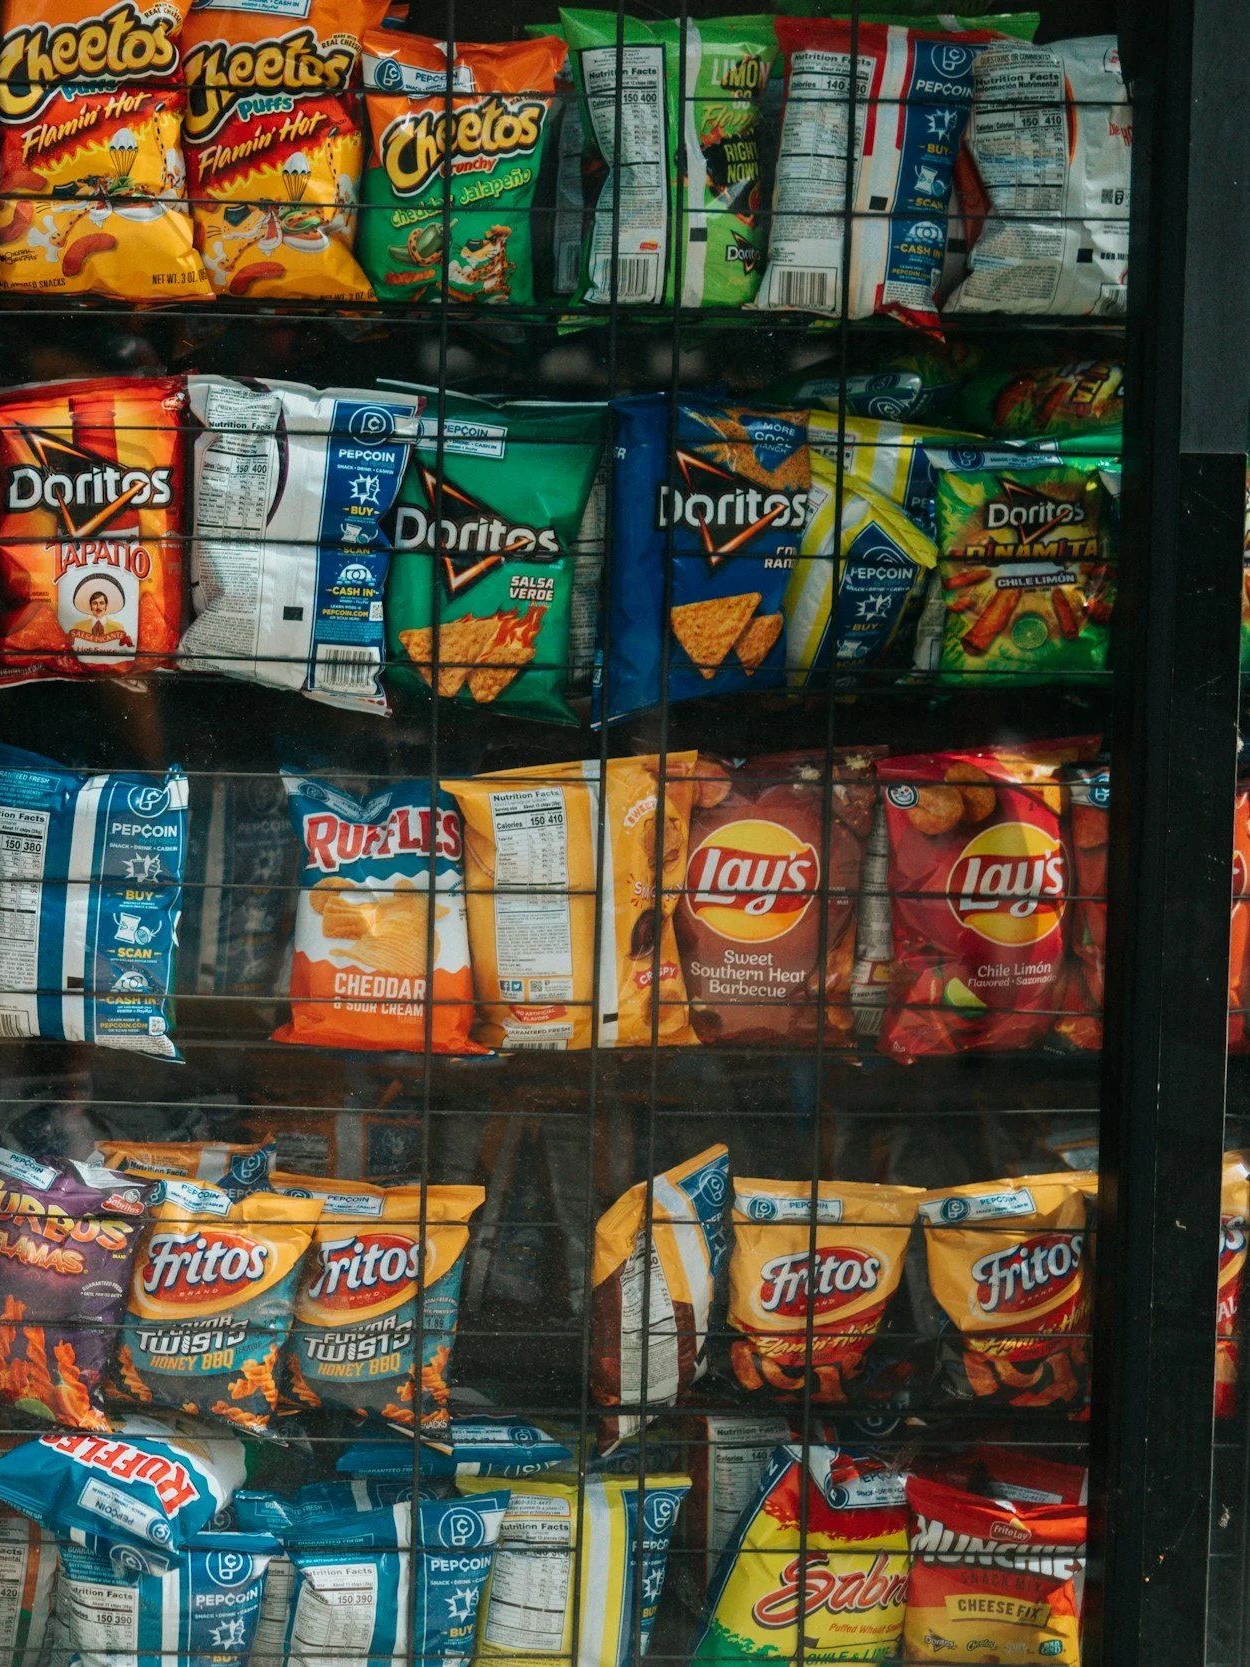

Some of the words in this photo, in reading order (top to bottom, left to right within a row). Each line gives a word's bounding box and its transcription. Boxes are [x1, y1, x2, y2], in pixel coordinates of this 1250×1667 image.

[0, 8, 173, 118] Cheetos
[632, 68, 656, 76] Facts
[185, 36, 353, 134] Cheetos
[827, 81, 844, 91] 140
[623, 93, 638, 103] 150
[640, 93, 657, 103] 400
[22, 107, 99, 164] Flamin'
[104, 93, 151, 117] Hot
[1021, 118, 1038, 126] 150
[1045, 116, 1062, 125] 410
[198, 129, 276, 184] Flamin'
[281, 113, 327, 144] Hot
[387, 98, 538, 191] Cheetos
[460, 169, 531, 204] Jalapeño
[209, 421, 247, 431] Nutrition
[764, 422, 795, 436] MORE
[236, 465, 249, 474] 150
[252, 464, 266, 473] 400
[10, 469, 171, 509] Doritos
[351, 507, 373, 515] BUY
[660, 487, 808, 526] Doritos
[989, 503, 1084, 527] Doritos
[396, 507, 559, 553] Doritos
[511, 576, 554, 587] SALSA
[998, 576, 1033, 587] CHILE
[332, 587, 357, 596] CASH
[511, 588, 554, 601] VERDE
[29, 776, 49, 784] FRESH
[493, 792, 533, 801] Nutrition
[536, 789, 561, 799] Facts
[19, 813, 45, 822] Facts
[497, 821, 523, 829] Calories
[530, 816, 545, 826] 150
[548, 813, 563, 824] 410
[307, 809, 462, 868] RUFFLES
[5, 841, 20, 849] 150
[23, 841, 41, 852] 380
[695, 850, 811, 916] Lay's
[961, 850, 1062, 916] Lay's
[126, 890, 153, 900] BUY
[118, 948, 151, 958] SCAN
[724, 950, 773, 965] Sweet
[691, 963, 765, 982] Southern
[768, 967, 805, 983] Heat
[978, 963, 1010, 977] Chile
[1014, 962, 1051, 975] Limón
[335, 973, 425, 999] CHEDDAR
[710, 979, 786, 998] Barbecue
[381, 1003, 424, 1016] CREAM
[144, 1235, 267, 1293] Fritos
[309, 1235, 420, 1298] Fritos
[972, 1234, 1082, 1312] Fritos
[151, 1355, 197, 1370] HONEY
[202, 1350, 234, 1369] BBQ
[318, 1361, 365, 1376] HONEY
[370, 1355, 400, 1374] BBQ
[541, 1523, 569, 1532] Facts
[0, 1588, 18, 1597] 420
[338, 1595, 353, 1604] 150
[356, 1594, 372, 1604] 390
[958, 1598, 1013, 1618] CHEESE
[97, 1615, 112, 1623] 150
[114, 1616, 132, 1625] 390
[449, 1627, 473, 1638] BUY
